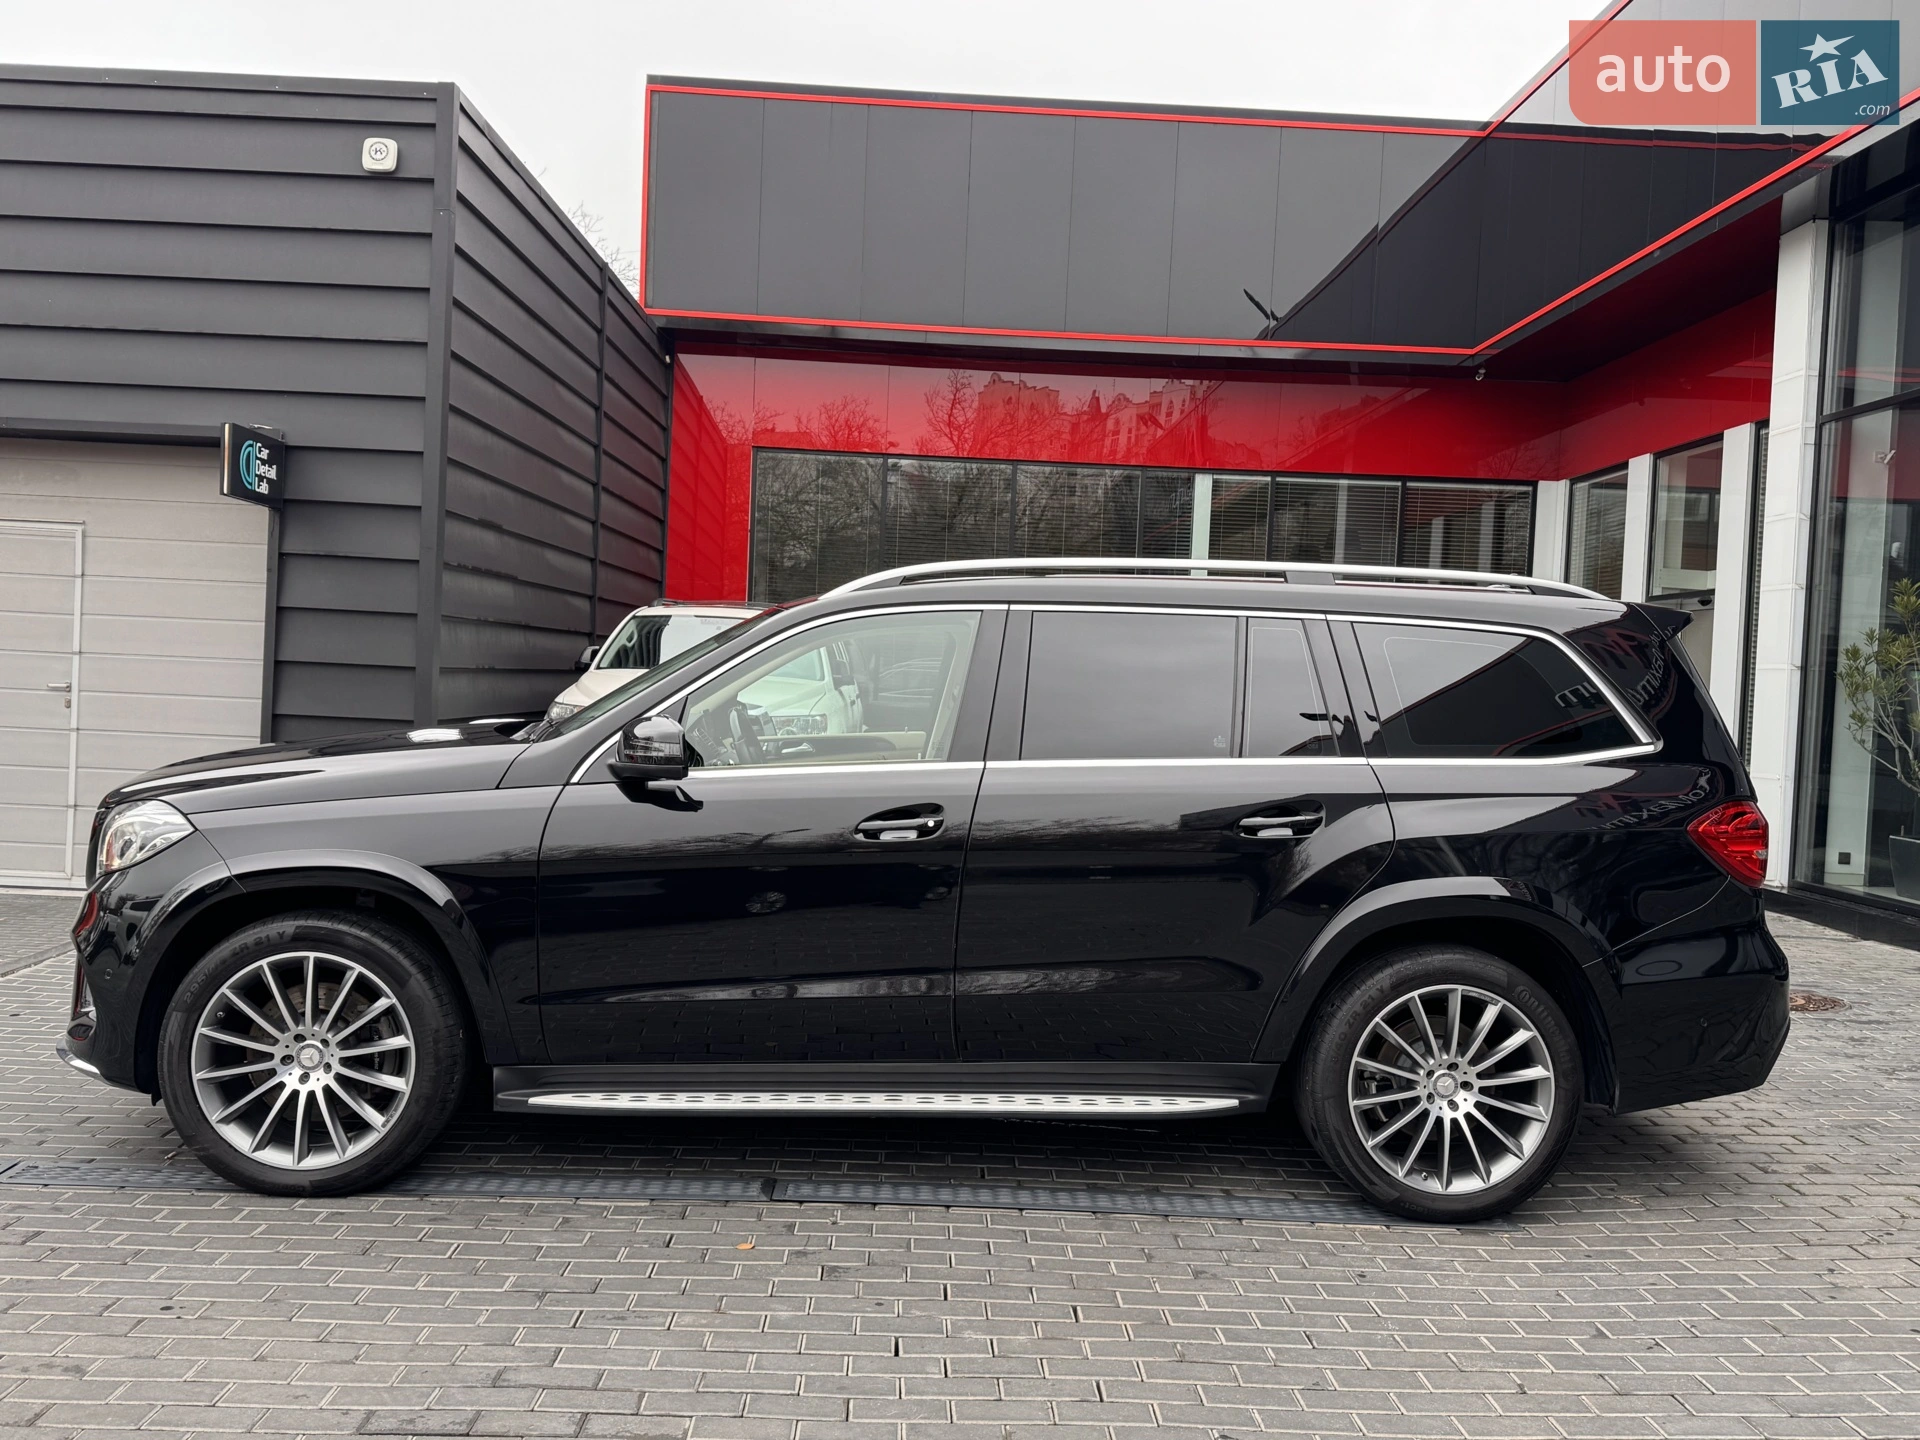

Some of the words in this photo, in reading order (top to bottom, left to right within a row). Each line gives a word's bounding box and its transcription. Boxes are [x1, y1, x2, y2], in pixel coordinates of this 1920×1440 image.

[256, 443, 270, 460] Car
[255, 460, 277, 480] Detail
[255, 477, 269, 494] Lab
[253, 933, 271, 947] 21
[276, 930, 286, 941] Y
